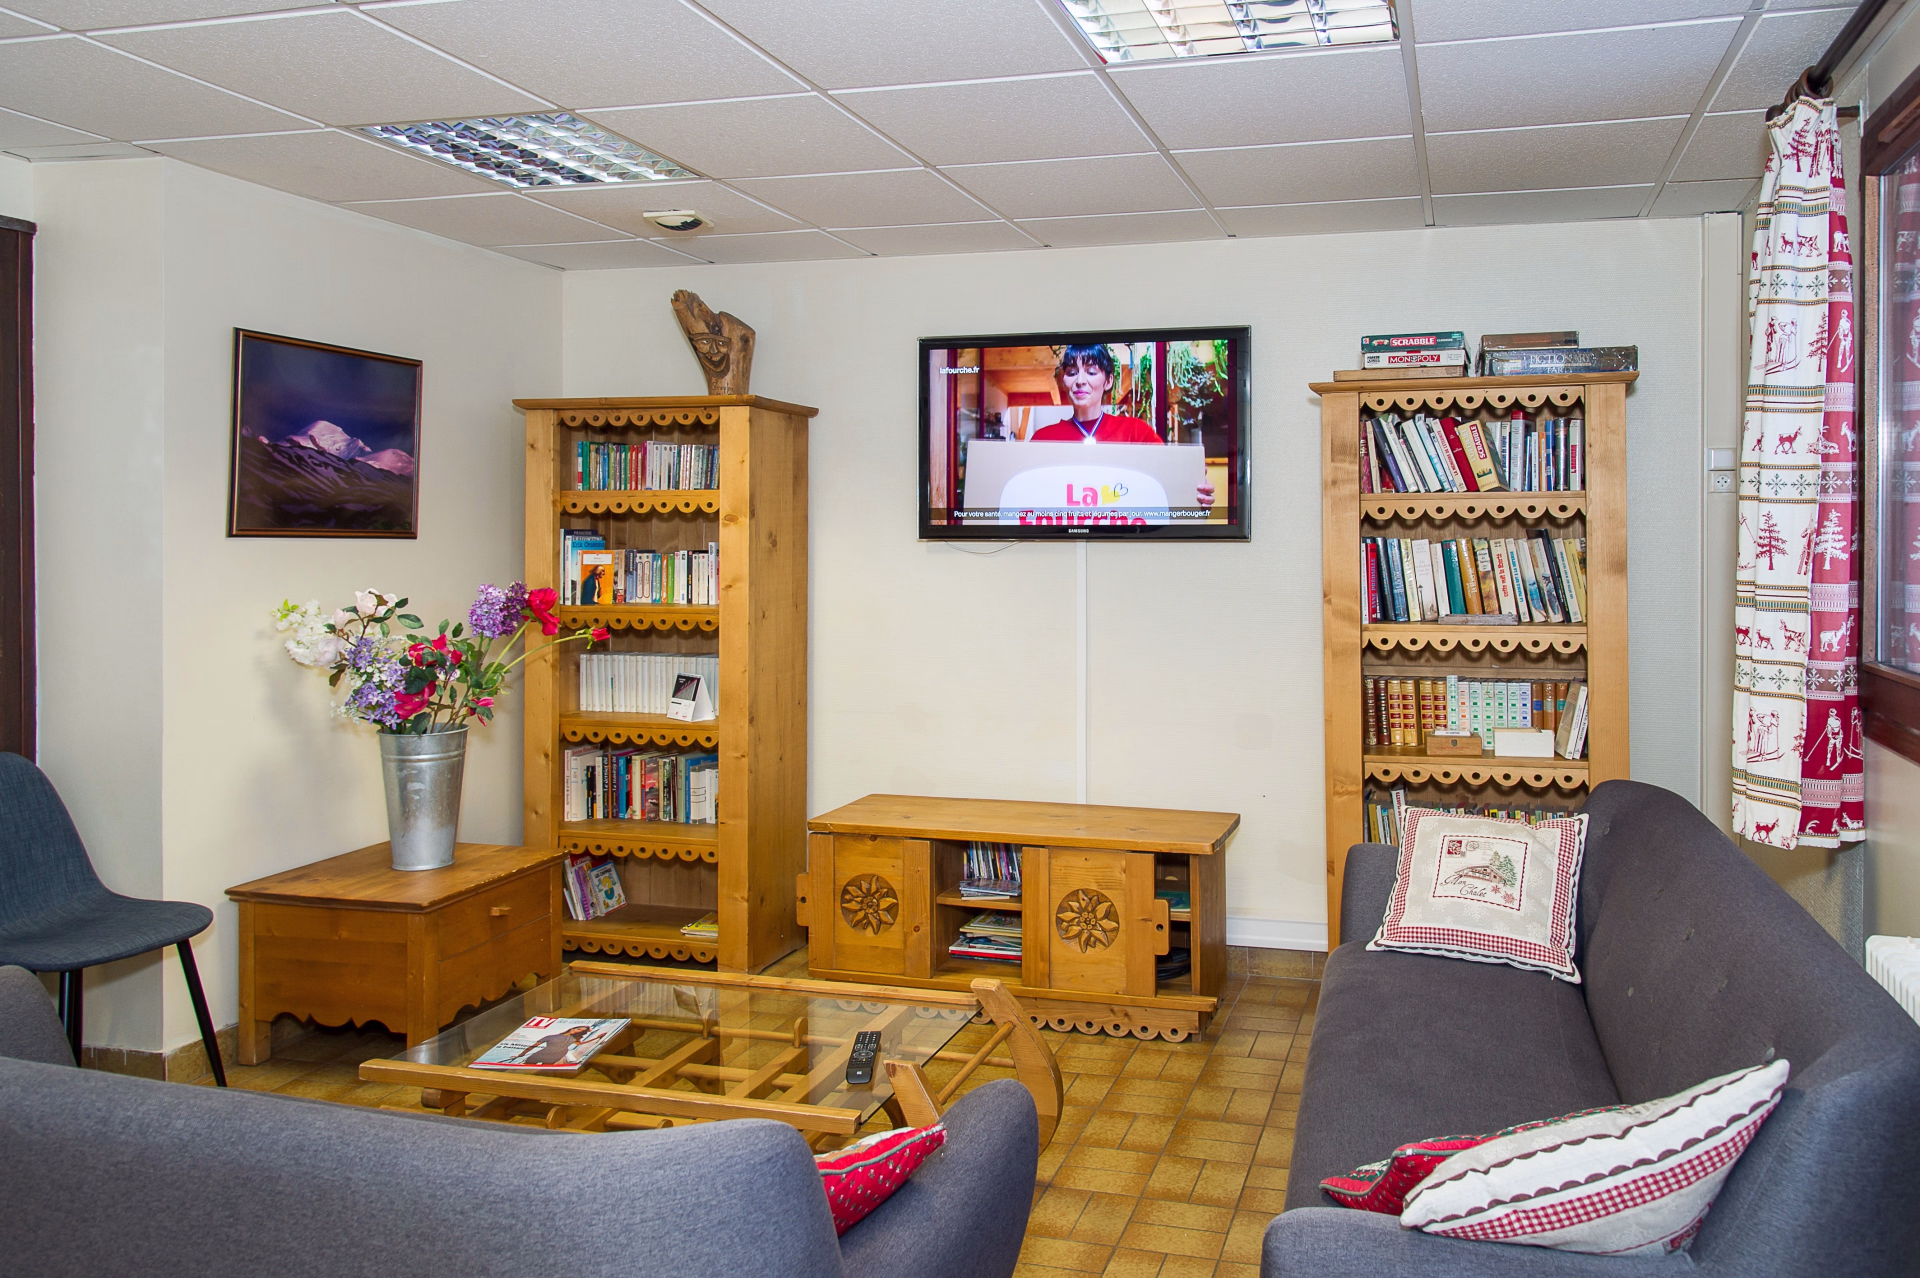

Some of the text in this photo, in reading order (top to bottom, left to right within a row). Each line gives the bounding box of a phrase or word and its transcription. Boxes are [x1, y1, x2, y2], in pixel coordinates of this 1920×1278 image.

[1392, 337, 1435, 346] SCRABBLE
[1389, 354, 1438, 363] MONOPOLY
[940, 366, 980, 374] lafourche.fr
[1470, 425, 1486, 459] SCRABBLE
[1066, 484, 1098, 507] La
[1460, 884, 1487, 897] Chalet
[529, 1018, 554, 1028] TV
